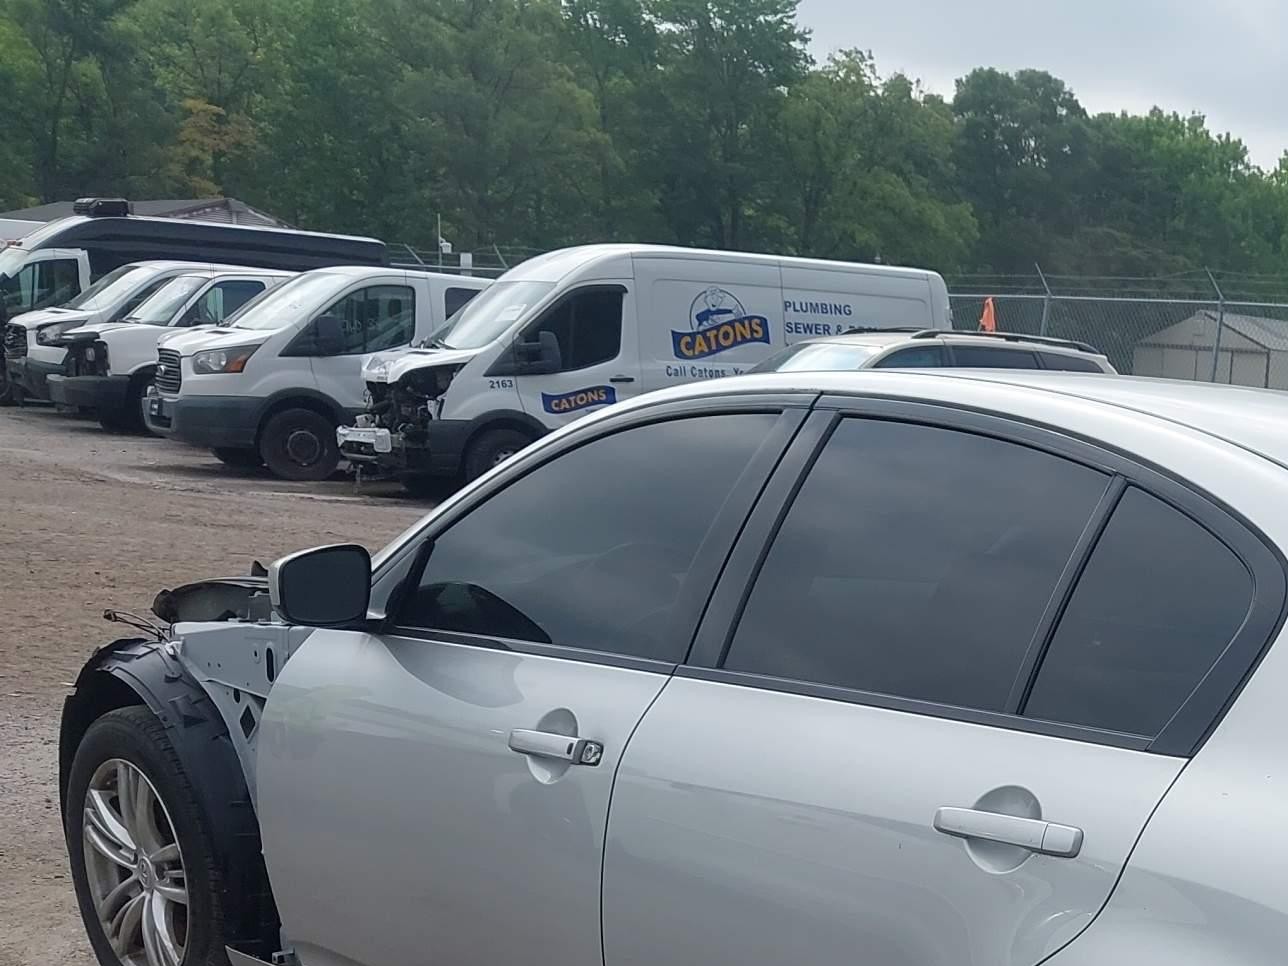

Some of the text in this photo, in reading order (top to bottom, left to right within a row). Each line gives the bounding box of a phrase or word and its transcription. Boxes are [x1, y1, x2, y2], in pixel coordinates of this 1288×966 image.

[783, 301, 852, 316] PLUMBING
[785, 322, 831, 335] SEWER
[680, 319, 763, 356] CATONS
[665, 366, 686, 377] Call
[489, 379, 513, 389] 2163
[550, 389, 607, 411] CATONS
